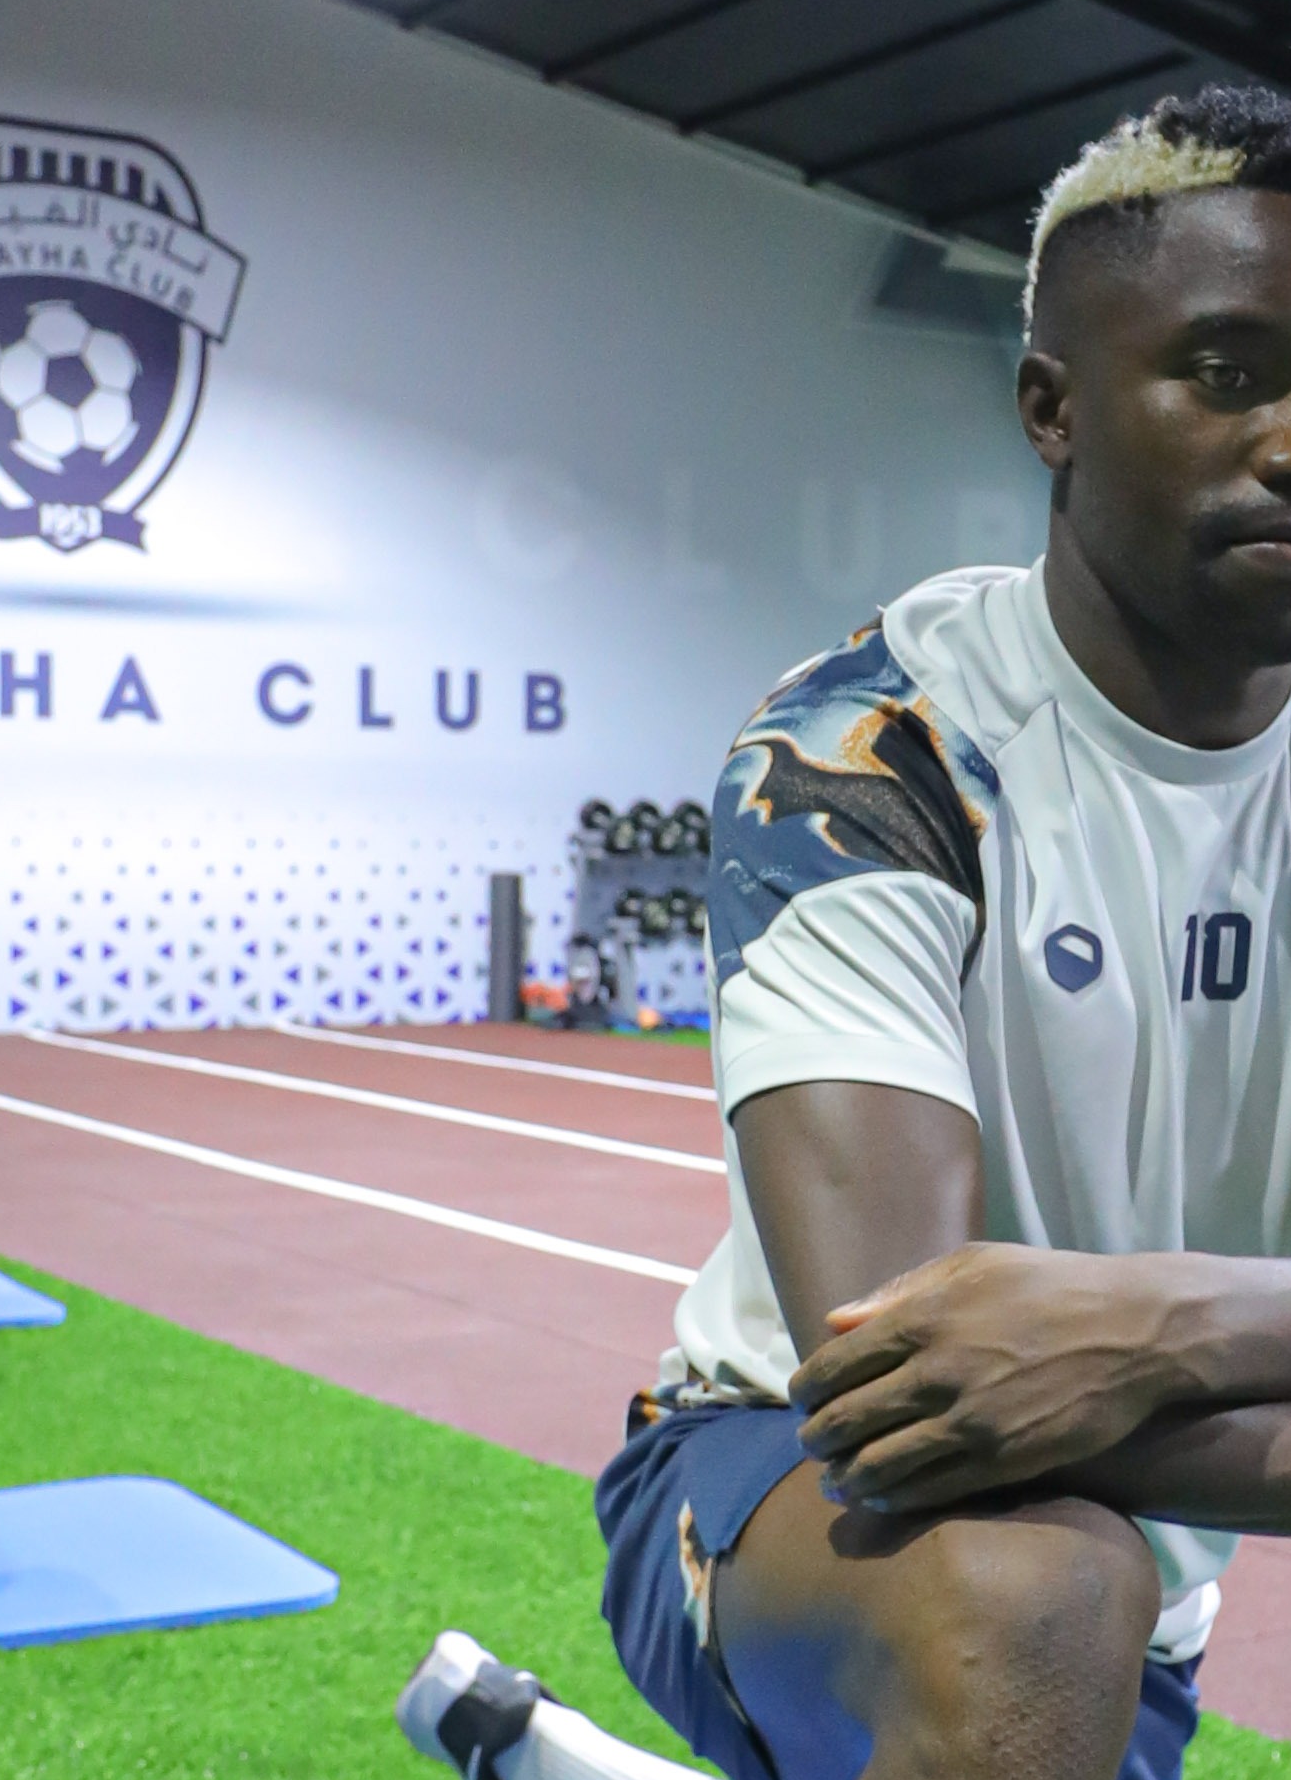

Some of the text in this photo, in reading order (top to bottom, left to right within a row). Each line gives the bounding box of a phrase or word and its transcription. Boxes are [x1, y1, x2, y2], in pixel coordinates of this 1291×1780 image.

[107, 254, 196, 316] CLUB
[257, 661, 568, 734] CLUB
[1181, 911, 1253, 1002] 10
